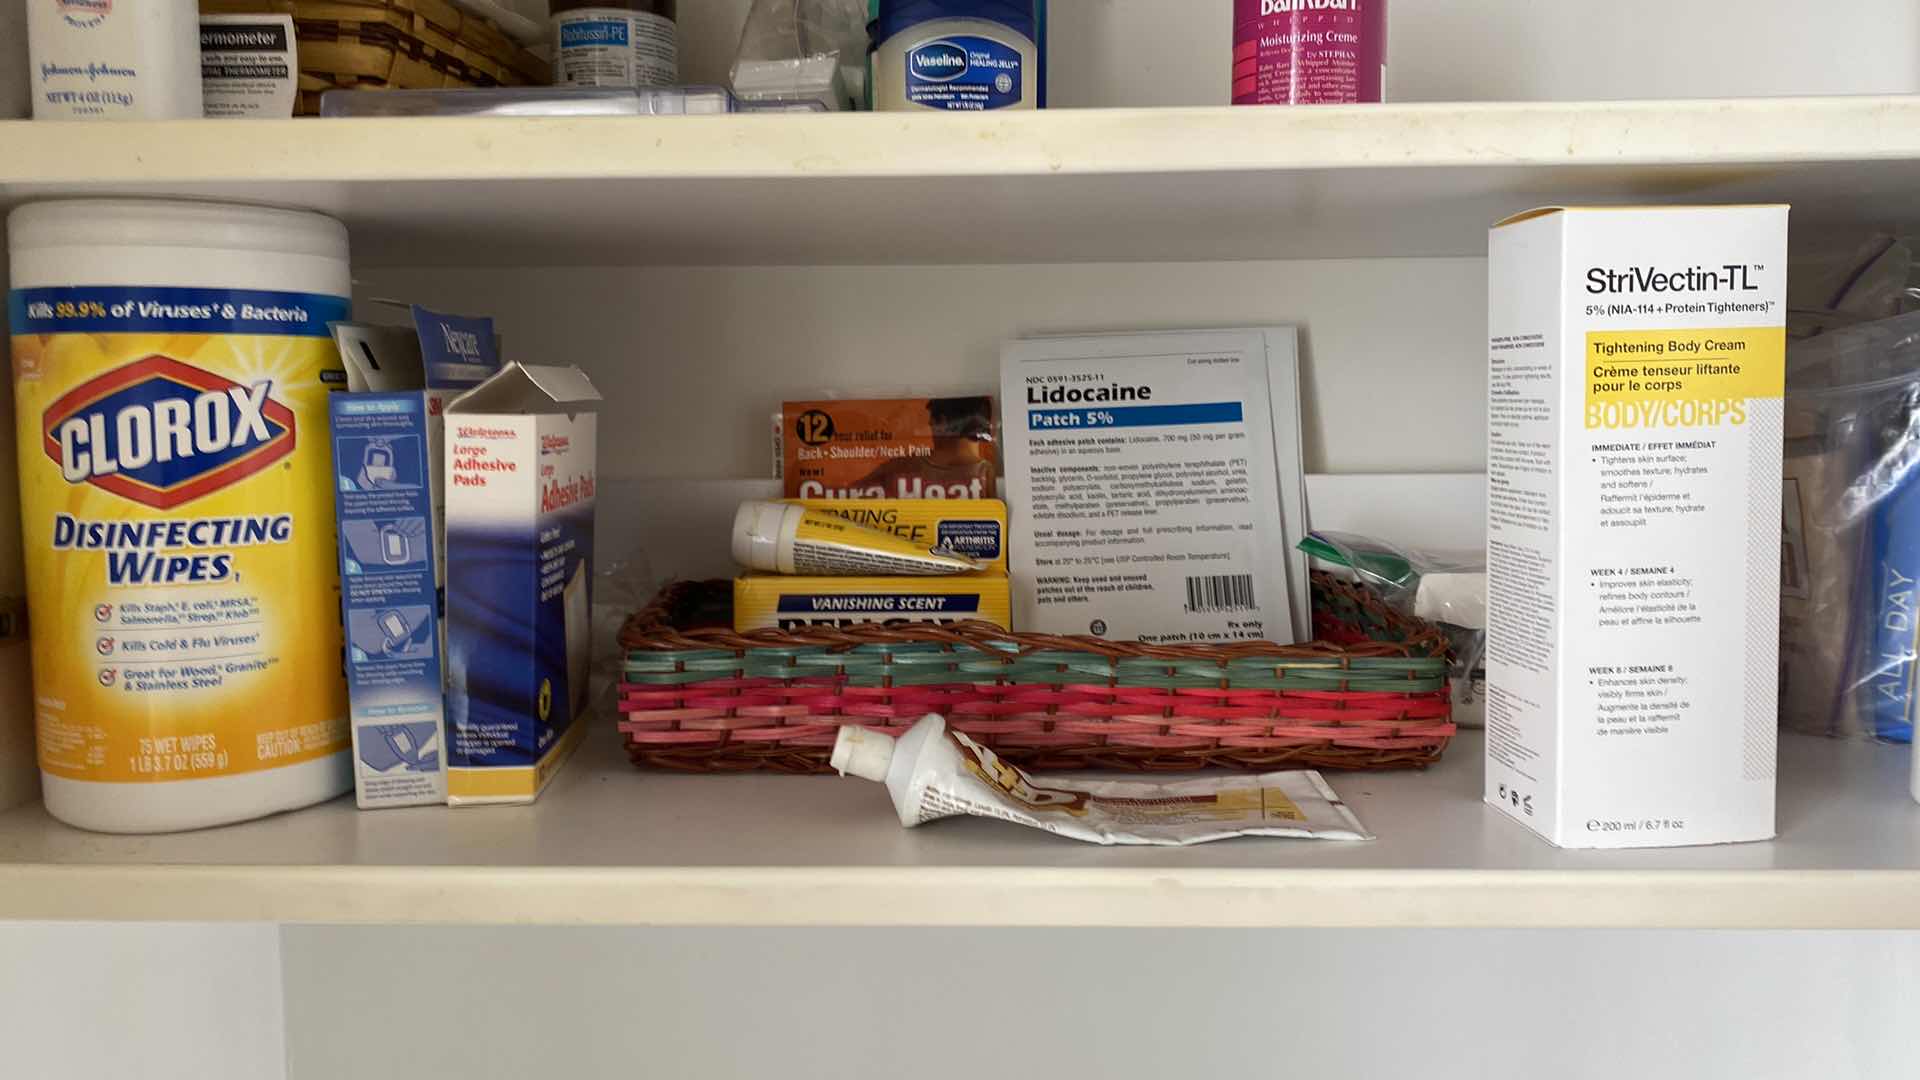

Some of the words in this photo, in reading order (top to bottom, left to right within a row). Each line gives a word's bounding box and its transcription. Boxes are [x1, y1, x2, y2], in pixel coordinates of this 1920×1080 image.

[1260, 30, 1323, 48] Moisturizing
[1326, 30, 1358, 44] Creme
[28, 303, 54, 320] Kills
[55, 302, 106, 320] 99.9%
[111, 300, 135, 318] of
[222, 302, 235, 320] &
[241, 303, 308, 322] Bacteria
[1585, 304, 1605, 316] 5%
[1607, 303, 1654, 317] (NIA-114
[1665, 302, 1706, 314] Protein
[1593, 341, 1664, 356] Tightening
[1668, 339, 1700, 354] Body
[1704, 339, 1746, 351] Cream
[1593, 365, 1638, 378] Crème
[1643, 366, 1691, 377] tenseur
[1696, 363, 1741, 375] liftante
[1593, 382, 1625, 394] pour
[1629, 380, 1640, 391] le
[1645, 381, 1682, 393] corps
[1027, 384, 1152, 405] Lidocaine
[1032, 412, 1080, 427] Patch
[1087, 411, 1114, 426] 5%
[1584, 399, 1747, 430] BODY/CORPS
[60, 380, 272, 483] CLOROX
[801, 414, 829, 442] 12
[1047, 438, 1076, 446] adhesive
[1648, 442, 1673, 450] EFFET
[453, 444, 488, 458] Large
[798, 446, 824, 460] Back
[908, 443, 931, 458] Pain
[454, 458, 517, 472] Adhesive
[1601, 455, 1636, 466] Tightens
[1638, 455, 1655, 464] skin
[1601, 468, 1640, 477] smoothes
[1674, 465, 1708, 477] hydrates
[454, 475, 487, 487] Pads
[1601, 481, 1617, 489] and
[1618, 480, 1648, 489] softens
[1683, 492, 1690, 500] et
[1633, 506, 1642, 514] sa
[1675, 504, 1705, 514] hydrate
[1600, 519, 1609, 527] et
[54, 515, 291, 549] DISINFECTING
[955, 535, 995, 545] ARTHRITIS
[1590, 568, 1616, 576] WEEK
[1630, 567, 1668, 575] SEMAINE
[1073, 575, 1090, 585] Keep
[1092, 574, 1108, 583] used
[1109, 574, 1121, 582] and
[1123, 573, 1147, 582] unused
[1639, 579, 1655, 588] skin
[1628, 591, 1648, 601] body
[1650, 591, 1684, 600] contours
[1885, 568, 1915, 632] DAY
[812, 597, 894, 611] VANISHING
[899, 596, 946, 610] SCENT
[1242, 619, 1263, 631] only
[1138, 633, 1158, 642] One
[1160, 632, 1186, 643] patch
[1189, 630, 1205, 641] (10
[1207, 632, 1221, 640] cm
[1233, 630, 1244, 639] 14
[122, 639, 146, 652] Kills
[150, 638, 177, 650] Cold
[179, 638, 188, 649] &
[192, 636, 210, 649] Flu
[124, 668, 155, 680] Great
[159, 666, 177, 678] for
[1588, 667, 1615, 675] WEEK
[1628, 665, 1666, 673] SEMAINE
[124, 681, 132, 691] &
[136, 678, 188, 691] Stainless
[192, 676, 222, 688] Steel
[154, 735, 177, 754] WET
[181, 733, 216, 753] WIPES
